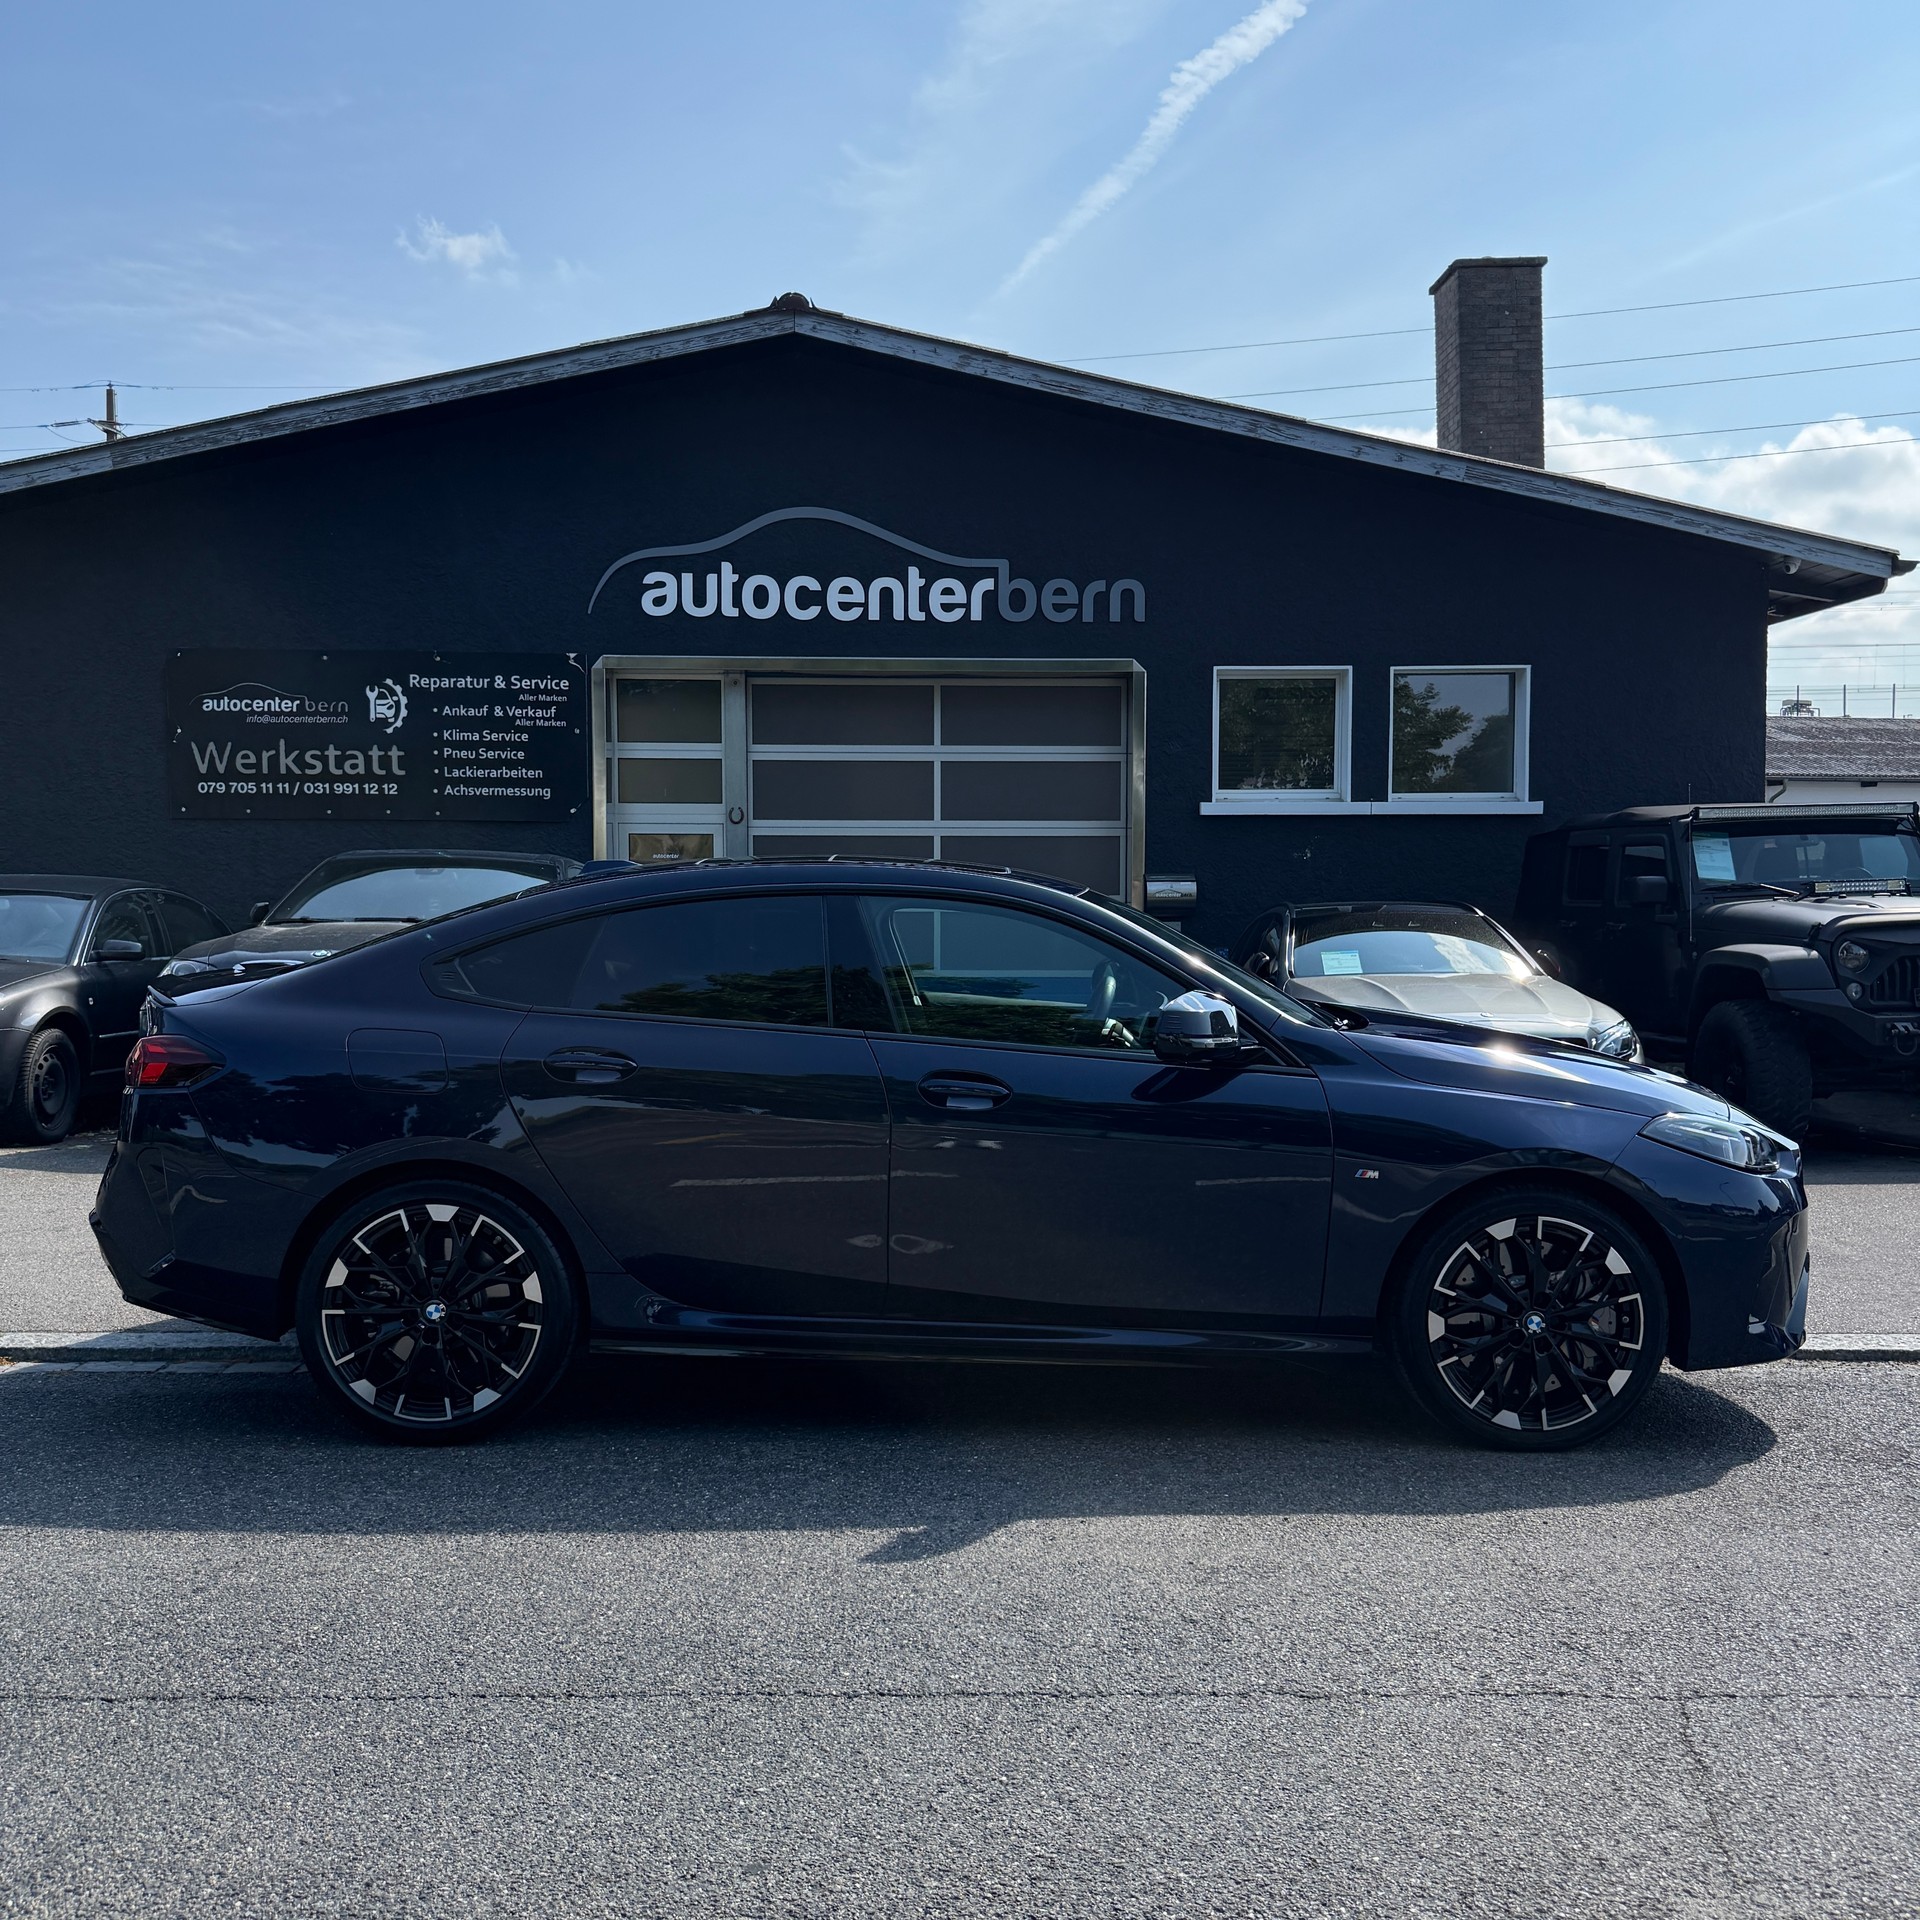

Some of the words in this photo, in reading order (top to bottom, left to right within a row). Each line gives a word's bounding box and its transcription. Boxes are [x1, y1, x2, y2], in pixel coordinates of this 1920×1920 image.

[410, 674, 490, 692] Reparatur
[494, 675, 506, 688] &
[511, 675, 569, 690] Service
[539, 694, 567, 702] Marken
[202, 696, 301, 712] autocenter
[304, 697, 349, 713] bern
[442, 705, 489, 716] Ankauf
[494, 706, 504, 716] &
[506, 706, 556, 717] Verkauf
[246, 714, 348, 724] info@autocenterbern.ch
[536, 719, 566, 727] Marken
[444, 729, 479, 741] Klima
[483, 730, 528, 741] Service
[191, 739, 405, 775] Werkstatt
[444, 748, 475, 759] Pneu
[479, 748, 525, 759] Service
[444, 766, 543, 778] Lackierarbeiten
[198, 782, 225, 793] 079
[229, 782, 257, 793] 705
[260, 782, 272, 793] 11
[277, 783, 289, 794] 11
[293, 782, 300, 795] /
[304, 783, 329, 794] 031
[334, 783, 359, 794] 991
[363, 783, 378, 794] 12
[382, 783, 398, 794] 12
[444, 784, 550, 799] Achsvermessung
